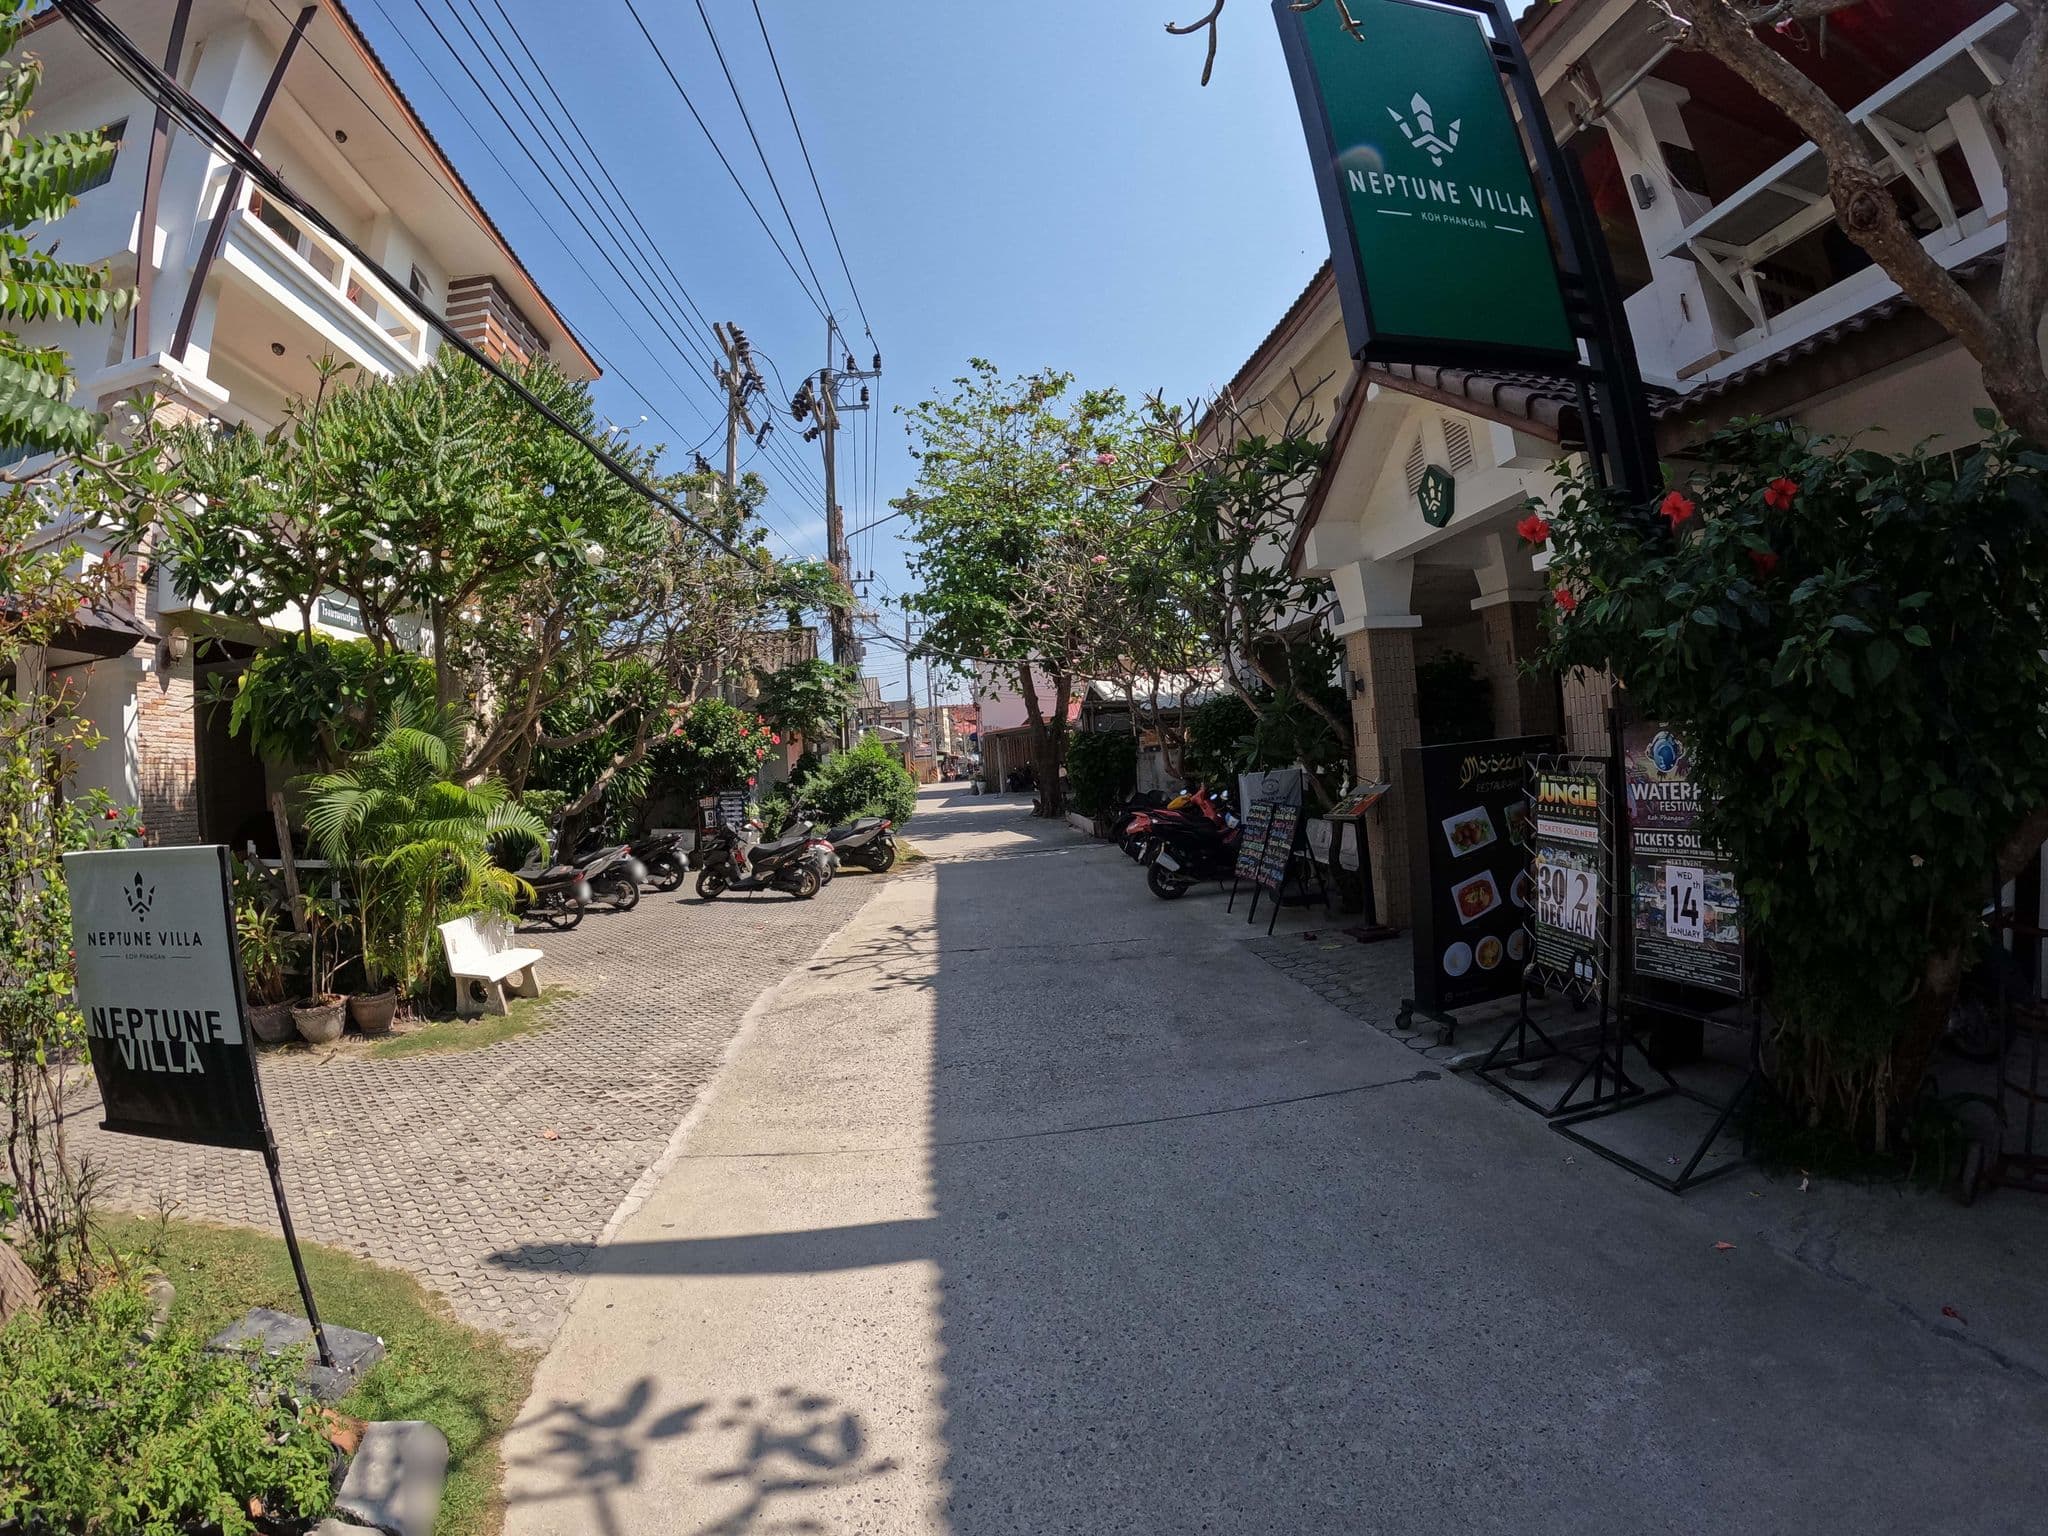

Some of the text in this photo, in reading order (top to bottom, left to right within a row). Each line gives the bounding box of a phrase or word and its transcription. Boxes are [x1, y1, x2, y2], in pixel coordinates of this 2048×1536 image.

[1348, 169, 1534, 218] NEPTUNE VILLA
[1420, 211, 1487, 229] KOH PHANGAN
[1538, 782, 1598, 807] JUNGLE
[1538, 804, 1597, 818] EXPERIENCE
[1539, 823, 1597, 838] TICKETS SOLD HERE
[1633, 833, 1675, 847] TICKETS
[1539, 865, 1565, 905] 30
[1676, 871, 1692, 880] WED
[1574, 873, 1589, 912] 2
[1670, 885, 1699, 926] 14
[1692, 880, 1701, 890] th
[1540, 901, 1564, 928] DEC
[1567, 908, 1592, 937] JAN
[87, 931, 203, 946] NEPTUNE VILLA
[1668, 926, 1701, 939] JANUARY
[90, 1006, 225, 1043] NEPTUNE
[117, 1039, 205, 1074] VILLA
